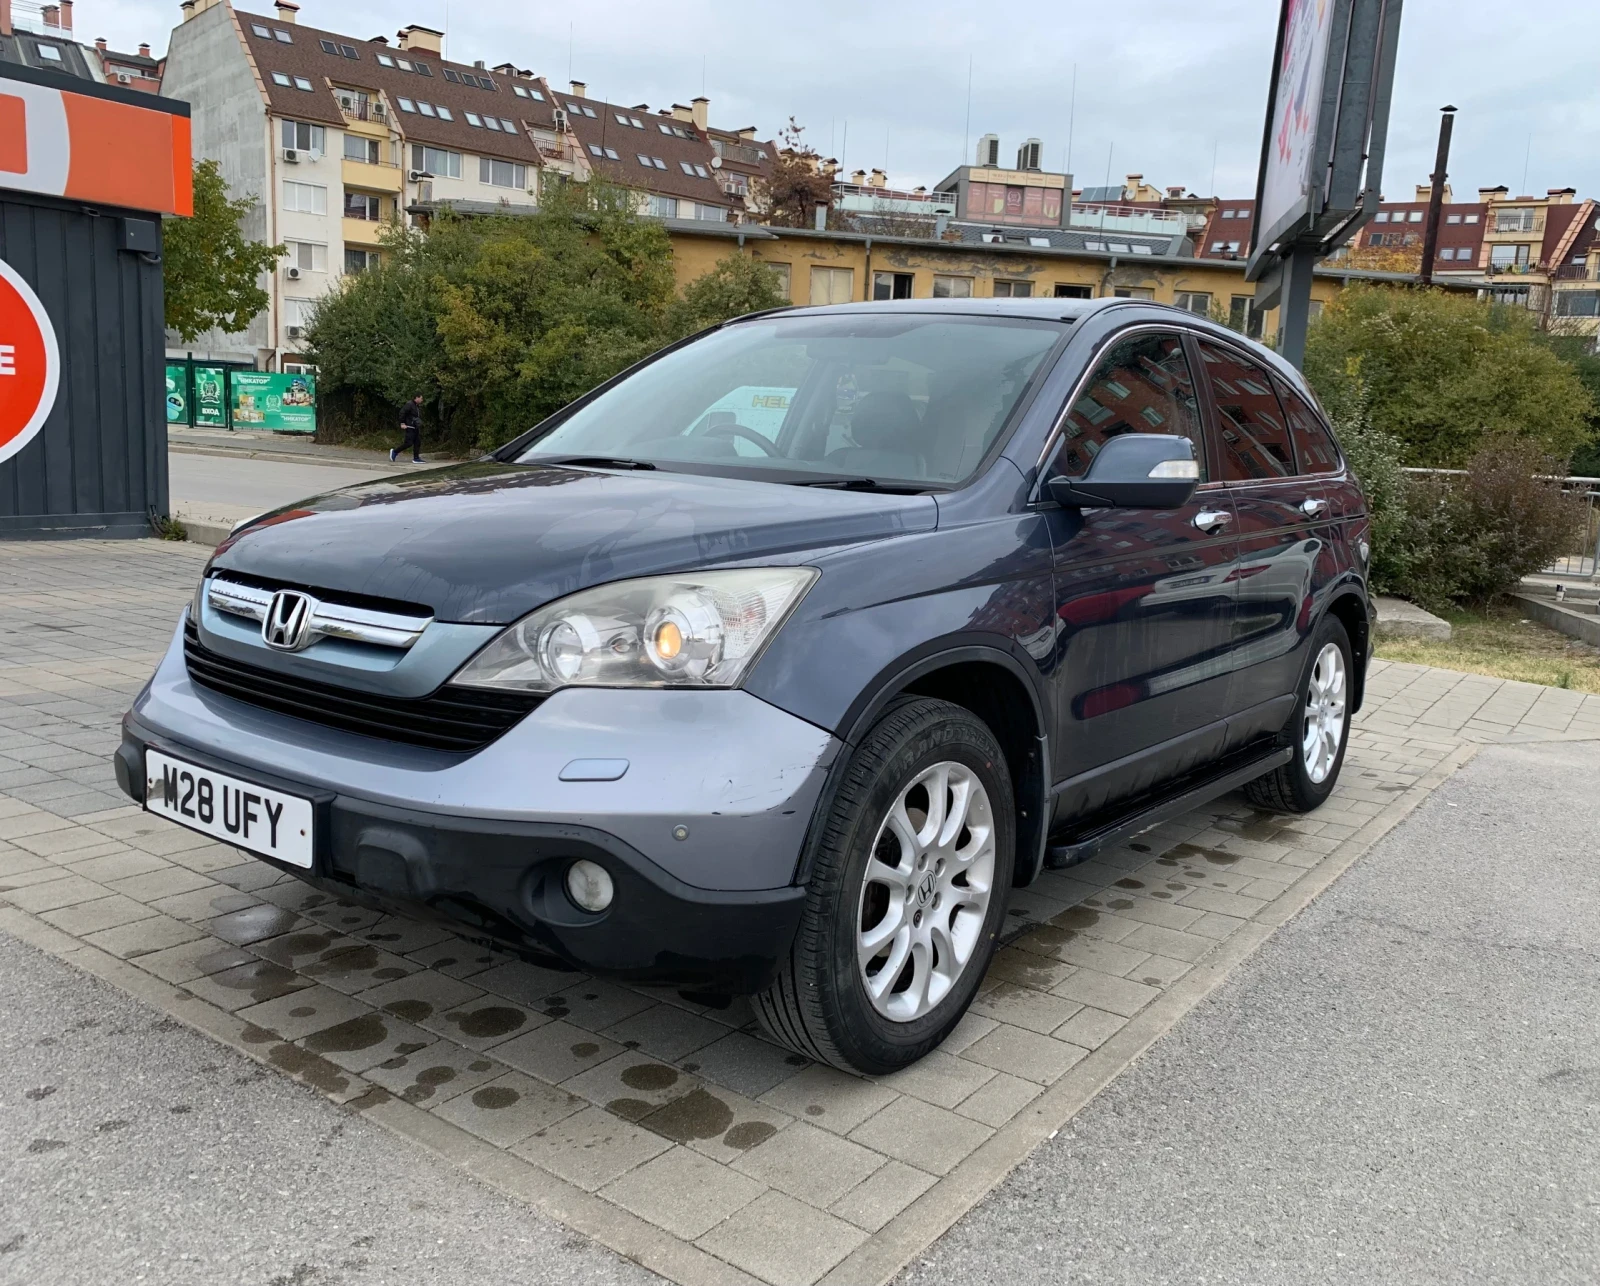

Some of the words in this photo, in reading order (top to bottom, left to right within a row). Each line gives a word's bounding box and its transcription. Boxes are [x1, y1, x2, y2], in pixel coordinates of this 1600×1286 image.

[202, 408, 220, 416] ВХОД
[163, 763, 214, 825] M28
[223, 785, 284, 849] UFY
